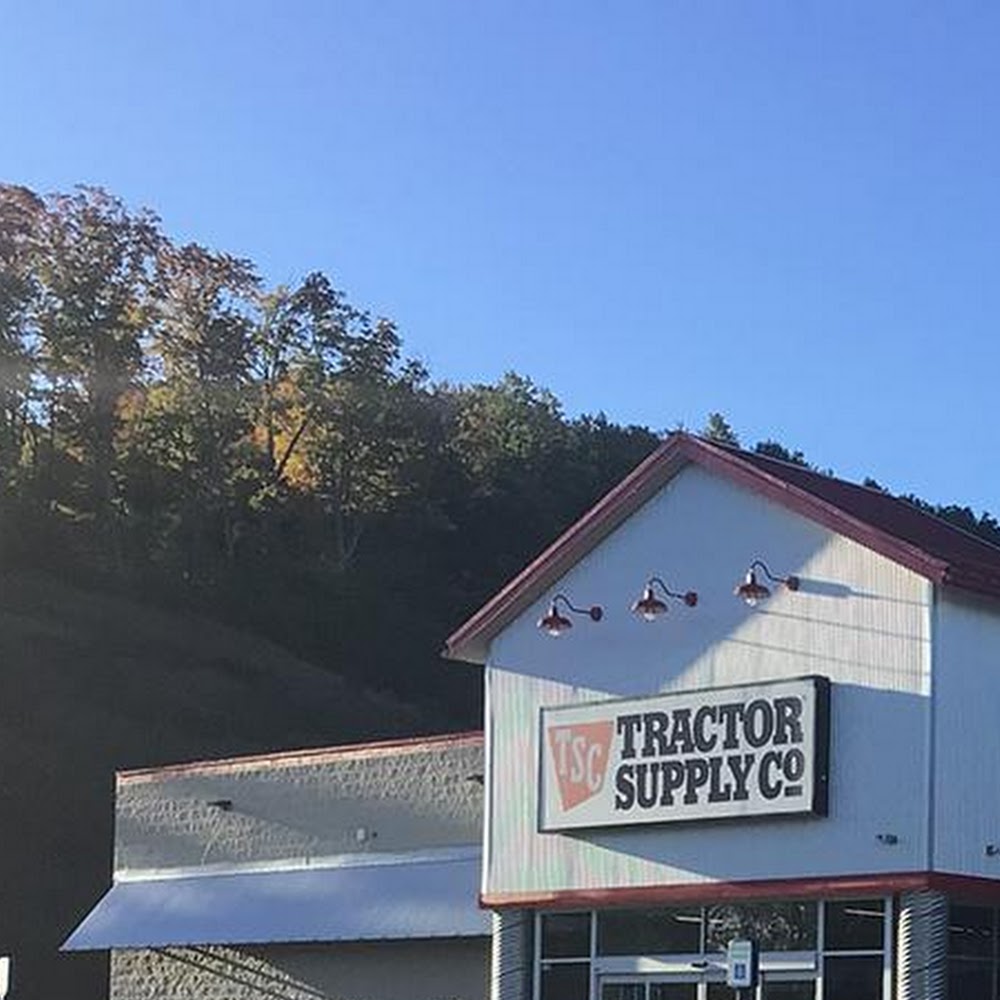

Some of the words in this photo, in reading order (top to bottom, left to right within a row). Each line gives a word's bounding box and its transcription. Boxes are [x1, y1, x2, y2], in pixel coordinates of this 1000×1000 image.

[617, 696, 804, 759] TRACTOR
[556, 728, 601, 793] TSC
[615, 756, 755, 810] SUPPLY
